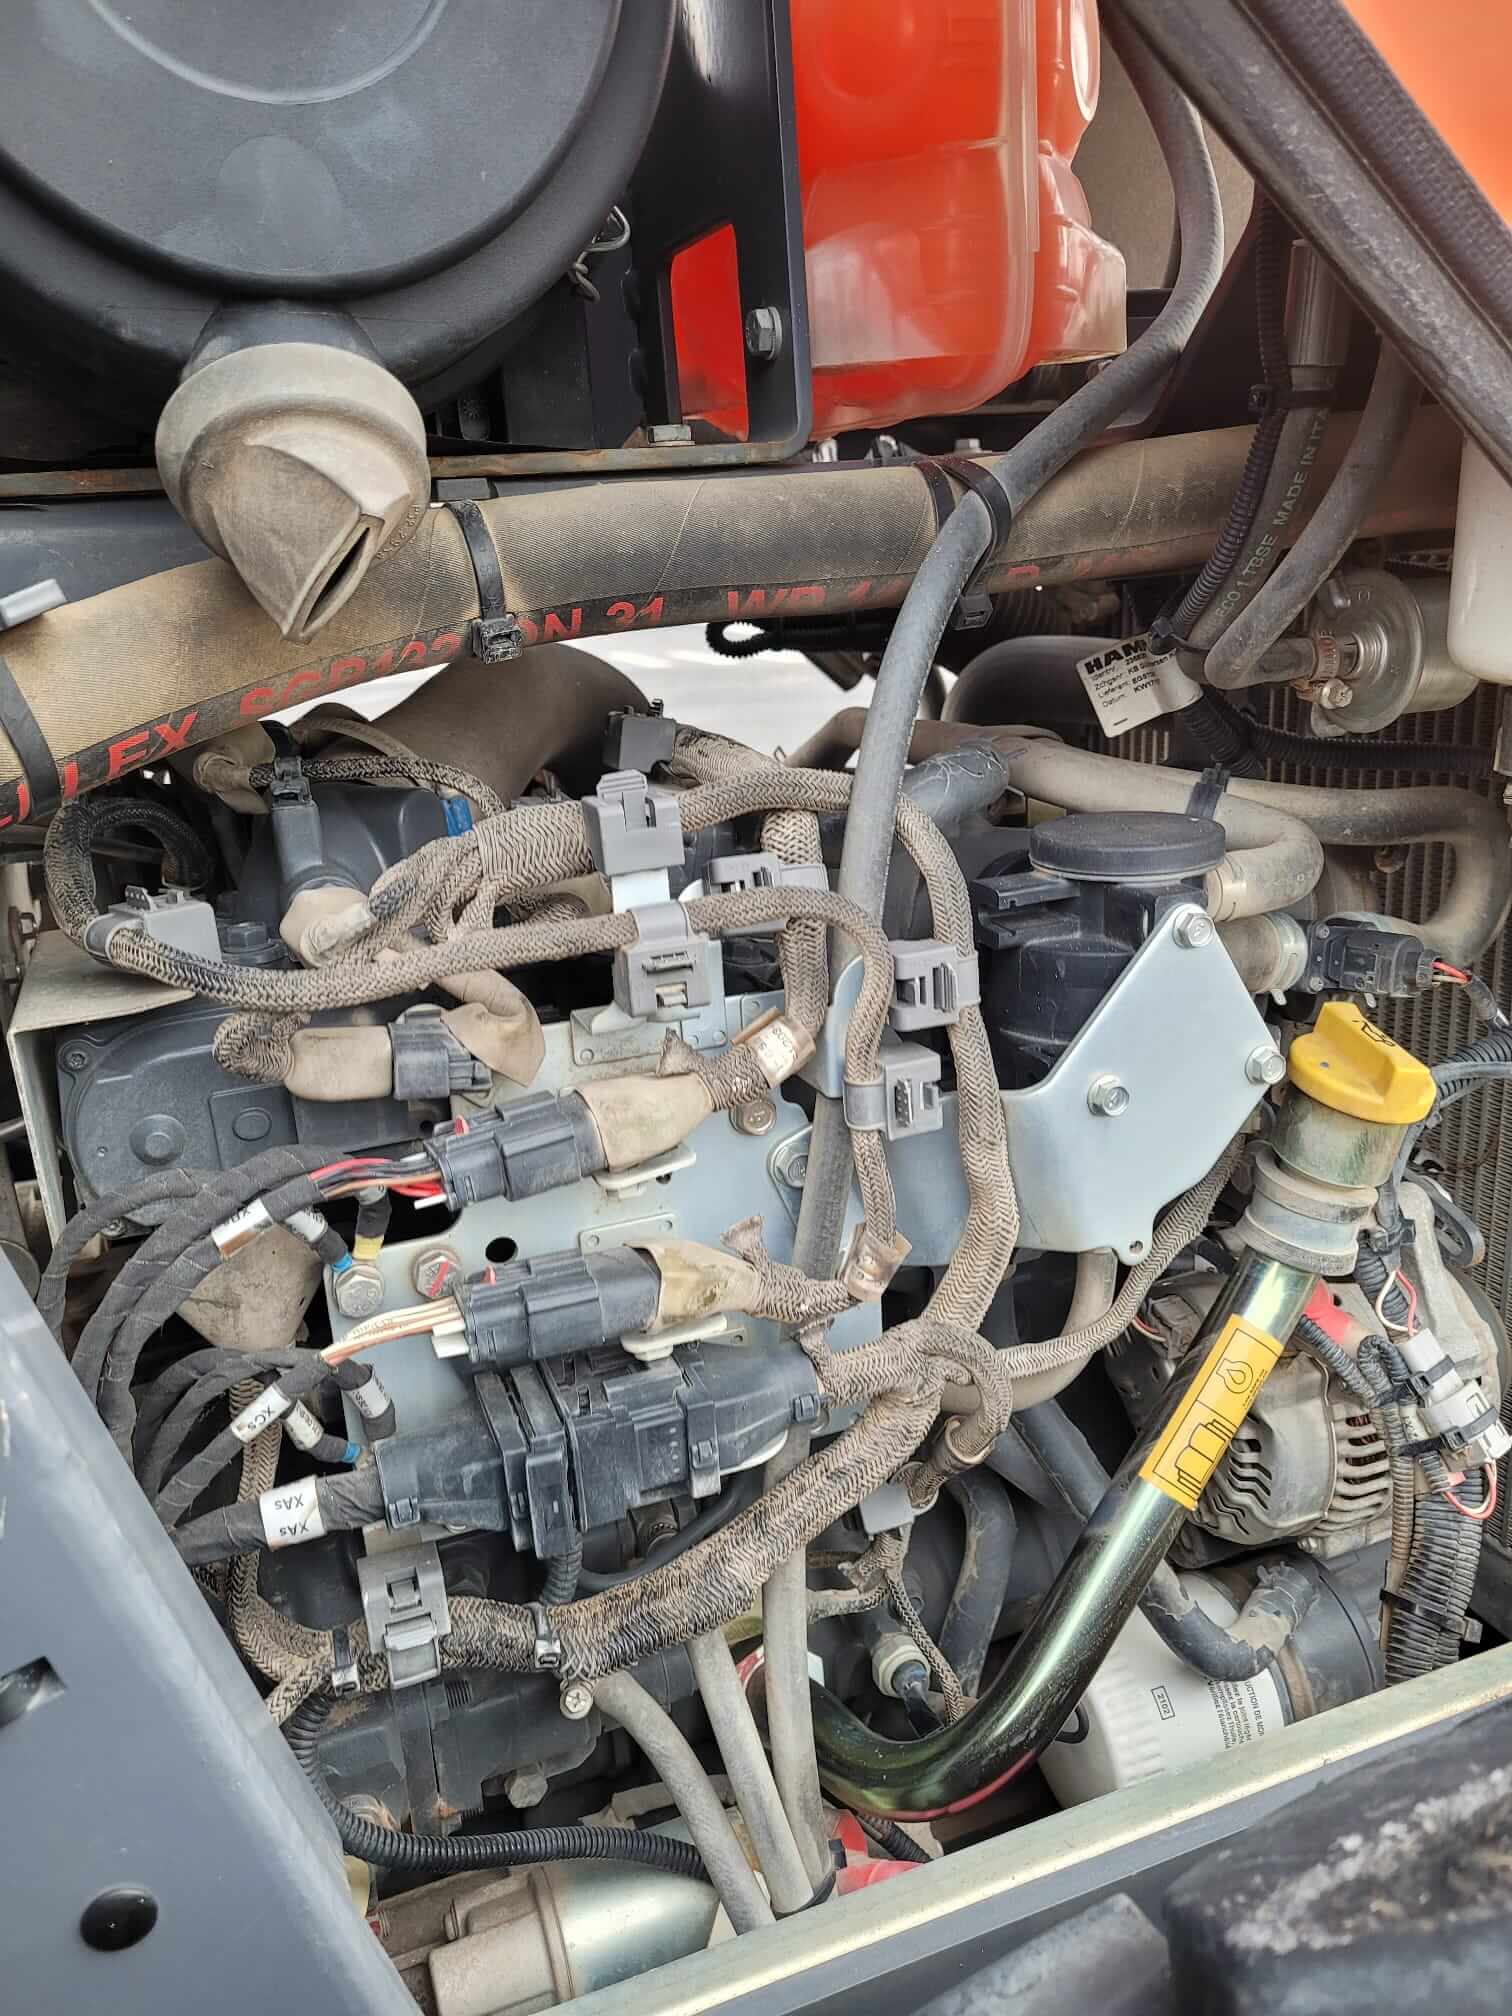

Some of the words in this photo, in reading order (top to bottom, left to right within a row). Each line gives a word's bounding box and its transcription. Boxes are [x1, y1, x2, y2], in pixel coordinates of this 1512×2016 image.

[1272, 471, 1308, 526] MADE
[1300, 446, 1316, 466] IN
[1308, 408, 1330, 442] ITA
[1083, 639, 1148, 675] HAM
[273, 1493, 305, 1511] XAs
[279, 1521, 311, 1537] XAs
[1156, 1692, 1171, 1716] 2102
[1252, 1709, 1262, 1720] DE
